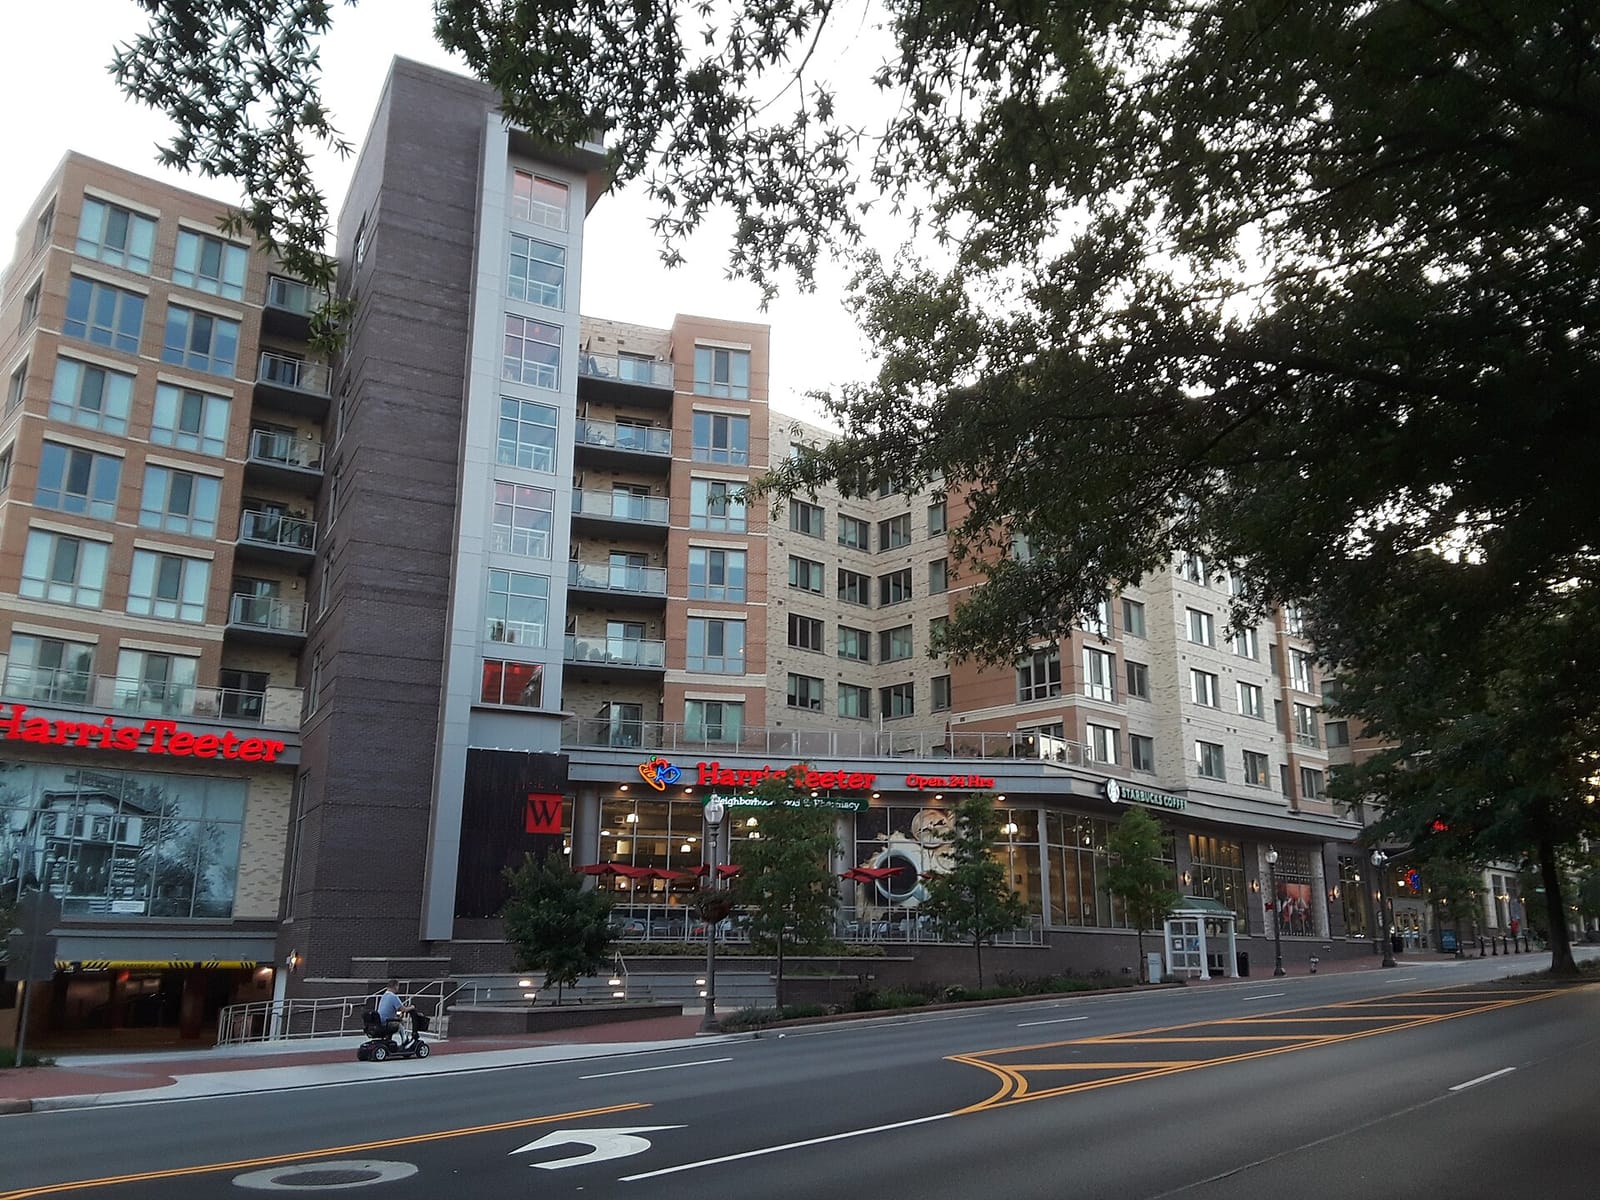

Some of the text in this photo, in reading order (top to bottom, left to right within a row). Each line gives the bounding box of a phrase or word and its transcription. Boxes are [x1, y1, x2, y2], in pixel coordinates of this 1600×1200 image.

[144, 720, 284, 762] Teeter
[905, 774, 995, 791] Open 24 Hrs
[1121, 787, 1162, 805] STARBUCKS
[529, 800, 562, 827] W
